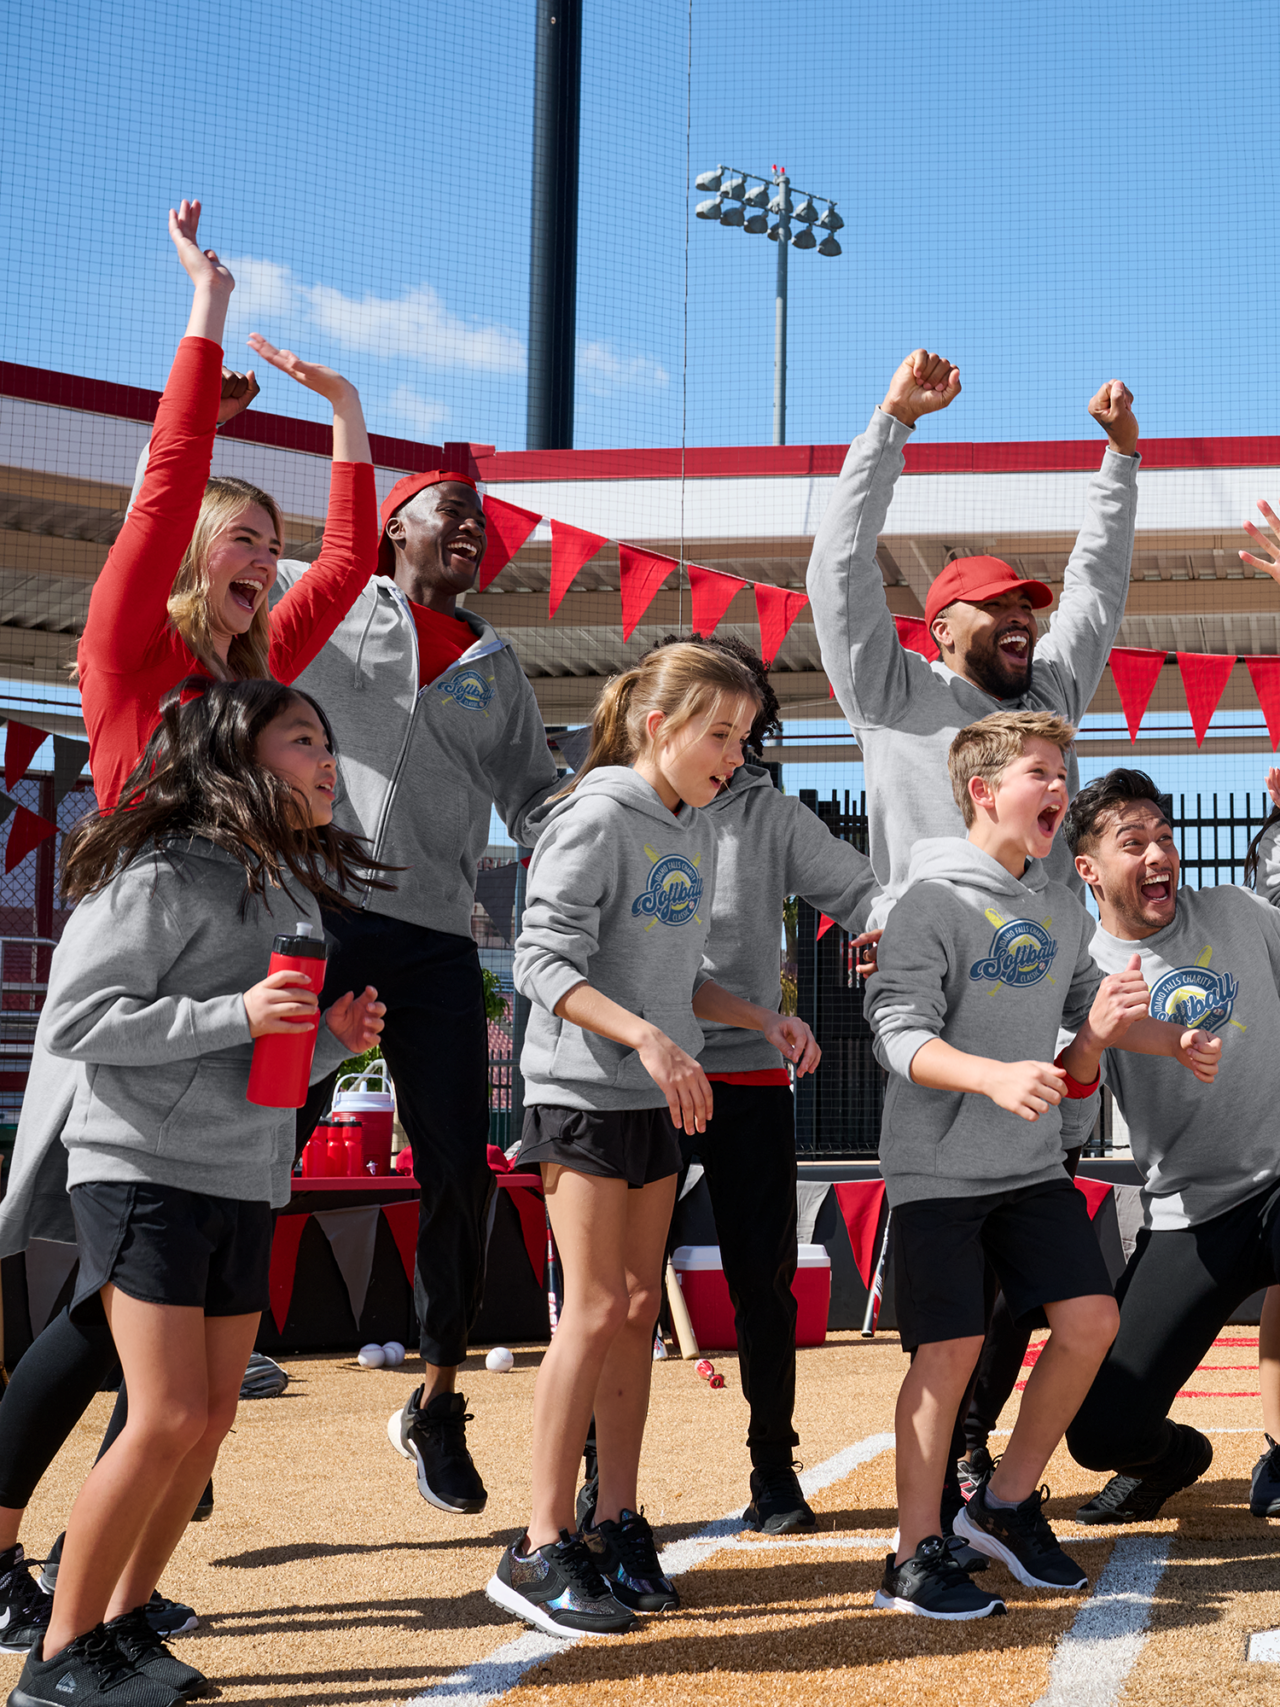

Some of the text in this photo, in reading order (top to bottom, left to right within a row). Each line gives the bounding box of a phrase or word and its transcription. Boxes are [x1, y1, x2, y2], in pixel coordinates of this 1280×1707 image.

[654, 861, 696, 882] IDAHO FALLS CHARITY
[672, 908, 690, 921] CLASSIC
[998, 925, 1047, 948] IDAHO FALLS CHARITY
[969, 939, 1059, 985] Softball
[1020, 969, 1040, 982] CLASSIC
[1154, 974, 1213, 1013] IDAHO FALLS CHARITY
